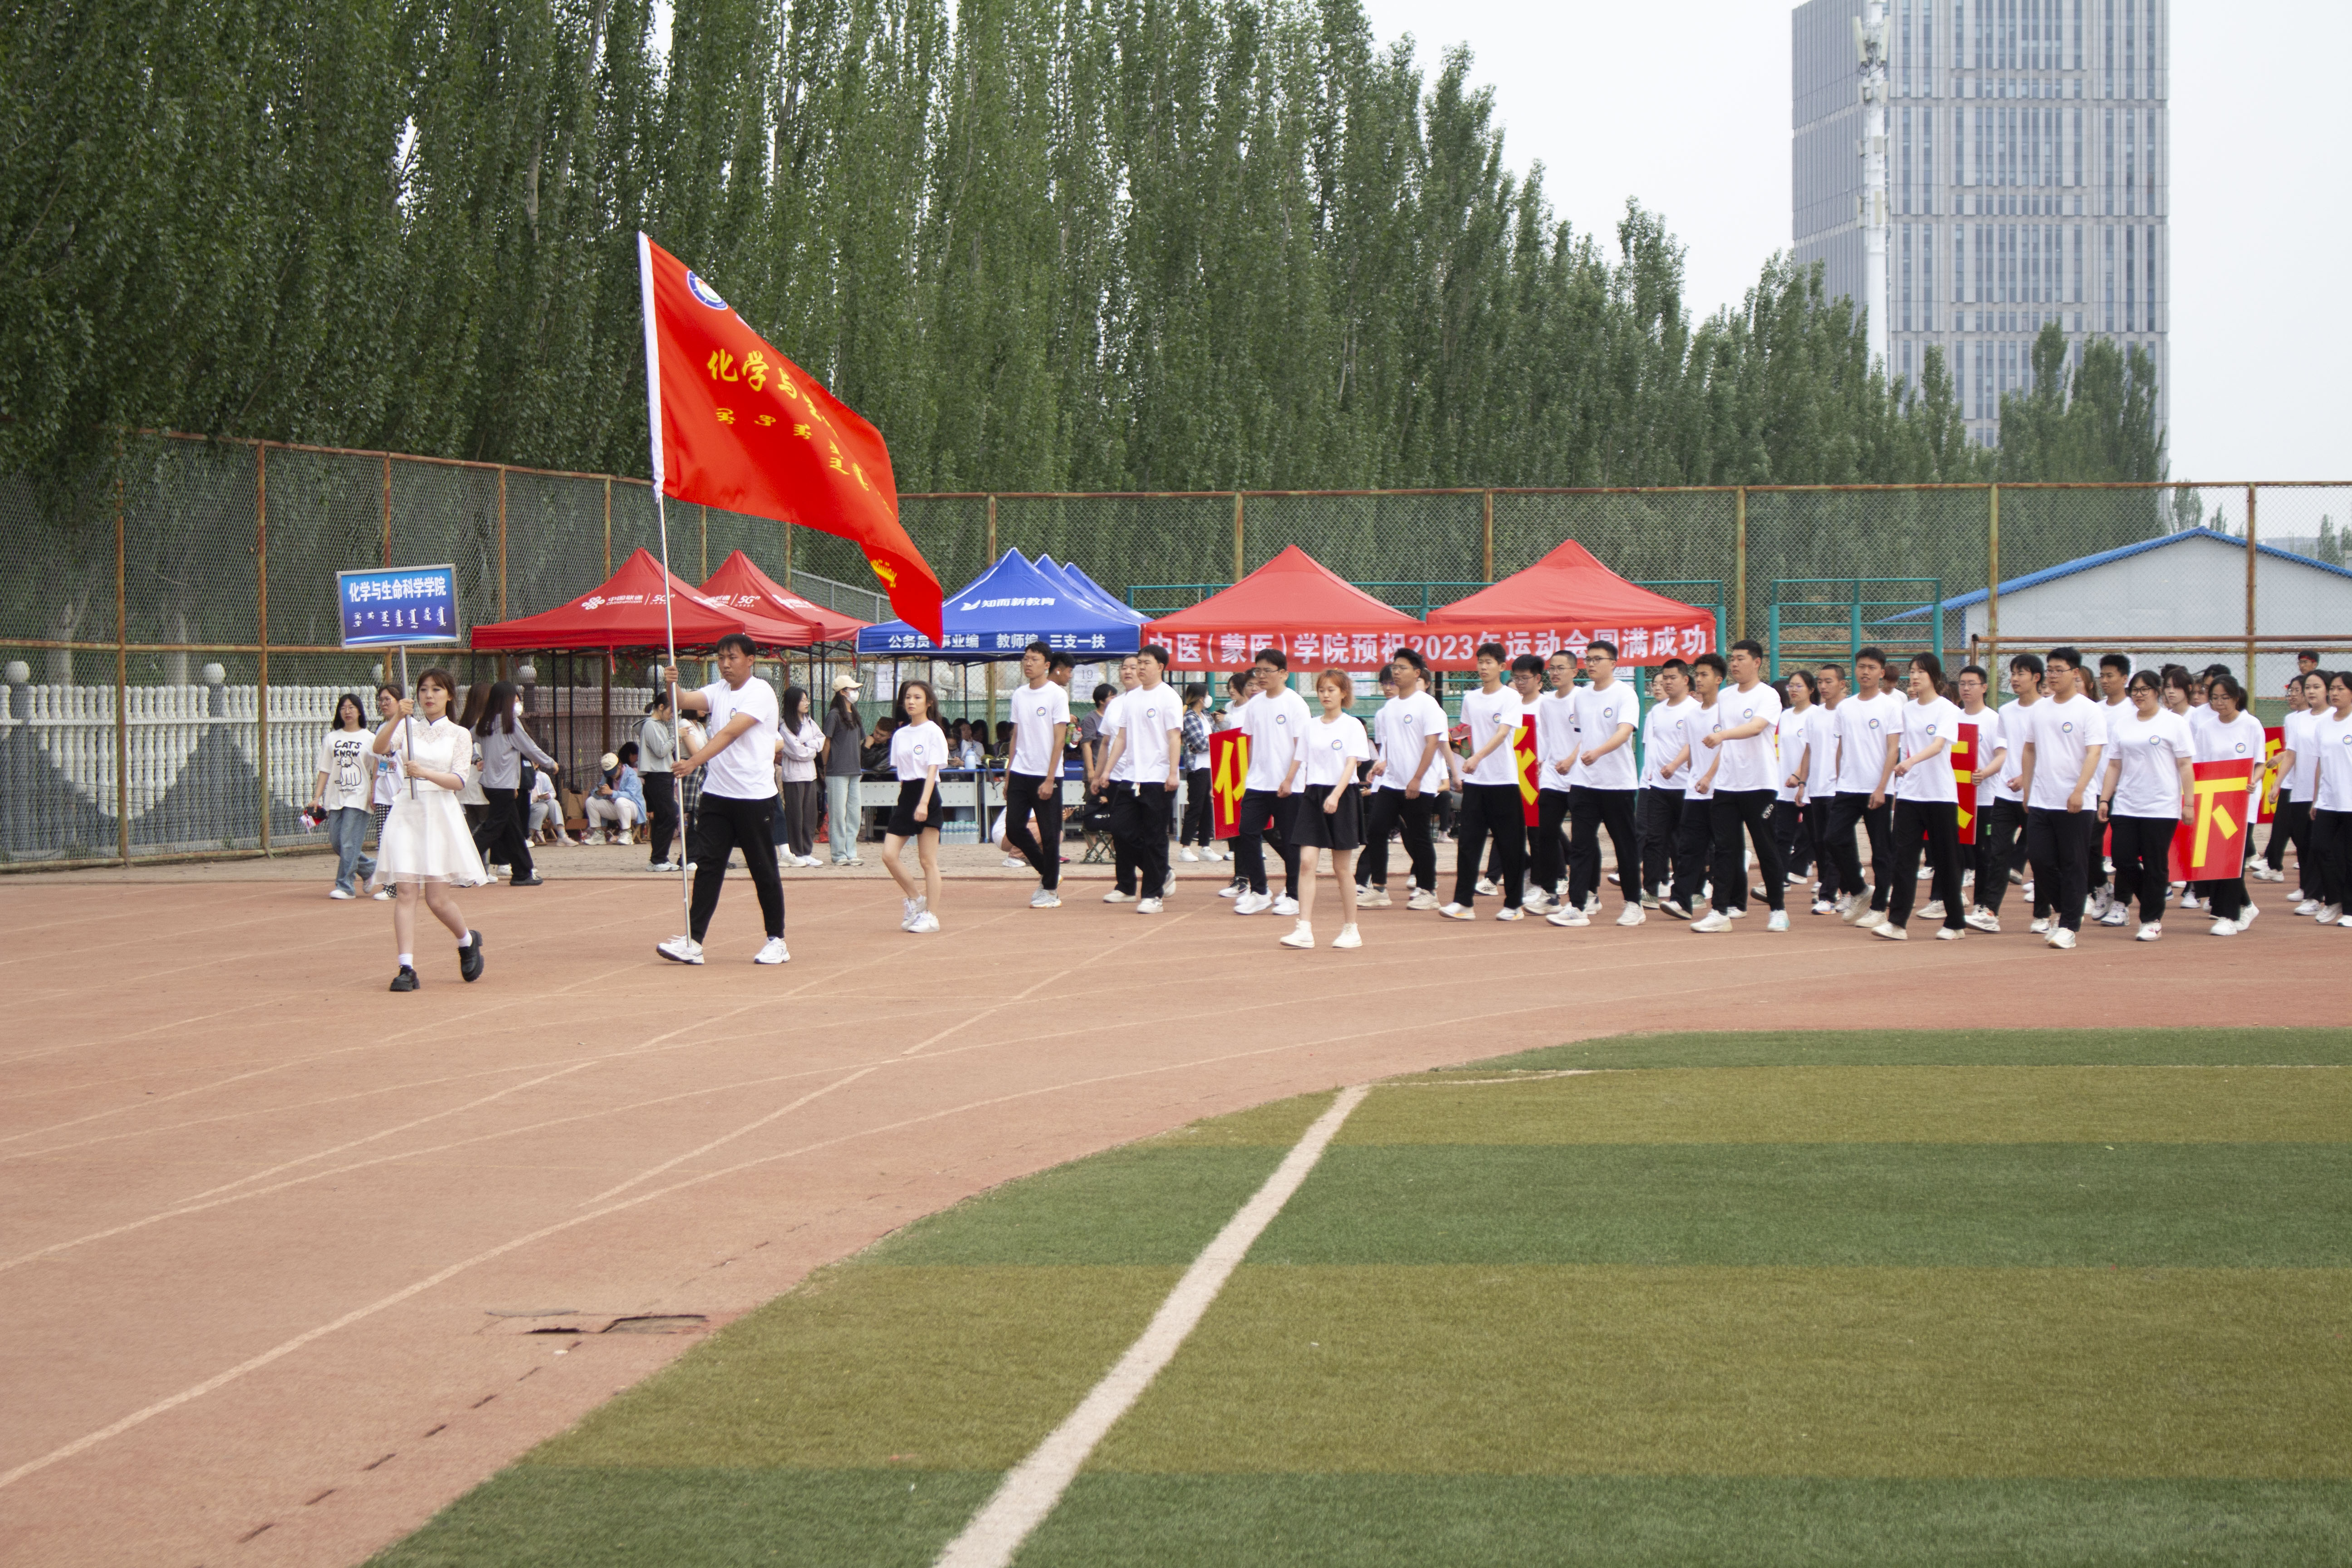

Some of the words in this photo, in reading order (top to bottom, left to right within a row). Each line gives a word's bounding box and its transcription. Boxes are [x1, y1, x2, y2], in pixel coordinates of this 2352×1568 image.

[349, 576, 446, 603] 化学与生命科学学院
[981, 598, 1056, 608] 知而新教育
[888, 635, 930, 649] 公务员
[942, 634, 979, 648] 事业编
[997, 634, 1039, 648] 教师编
[1049, 634, 1106, 649] 三支一扶
[1082, 669, 1093, 680] 19
[335, 740, 362, 749] CATS
[333, 749, 360, 758] KNOW
